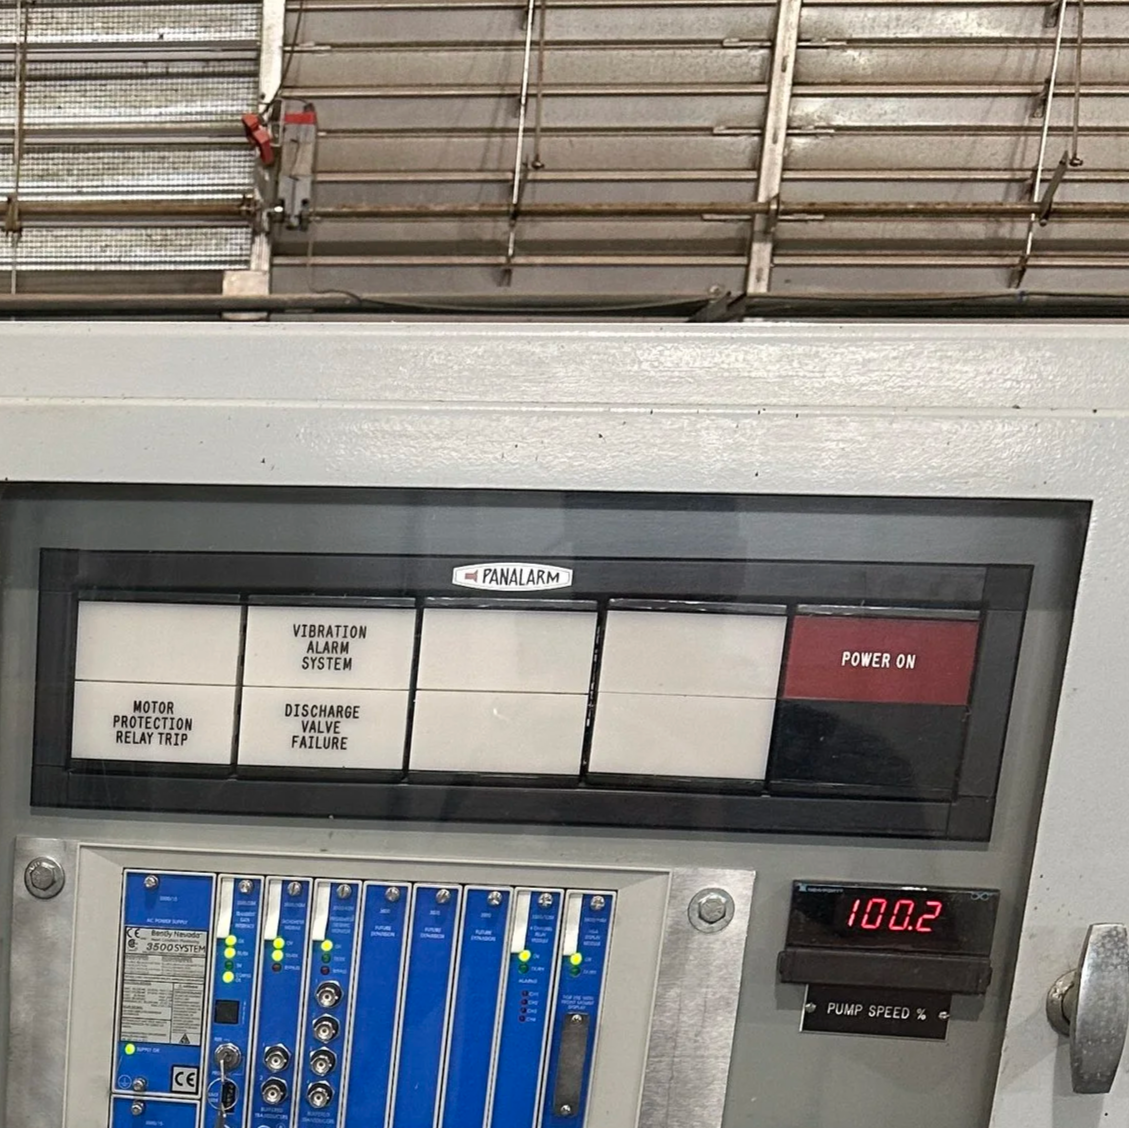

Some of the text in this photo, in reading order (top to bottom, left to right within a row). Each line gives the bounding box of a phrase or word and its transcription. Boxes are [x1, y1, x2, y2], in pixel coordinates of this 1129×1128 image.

[482, 568, 560, 586] PANALARM
[292, 624, 367, 640] VIBRATION
[306, 640, 350, 654] ALARM
[301, 656, 352, 671] SYSTEM
[841, 651, 916, 670] POWER ON
[133, 700, 174, 715] MOTOR
[284, 704, 360, 720] DISCHARGE
[112, 716, 192, 732] PROTECTION
[300, 720, 341, 734] VALVE
[116, 730, 188, 746] RELAY TRIP
[291, 735, 348, 750] FAILURE
[848, 898, 942, 932] 100.2
[146, 942, 206, 952] 3500 SYSTEM
[827, 1002, 926, 1020] PUMP SPEED %
